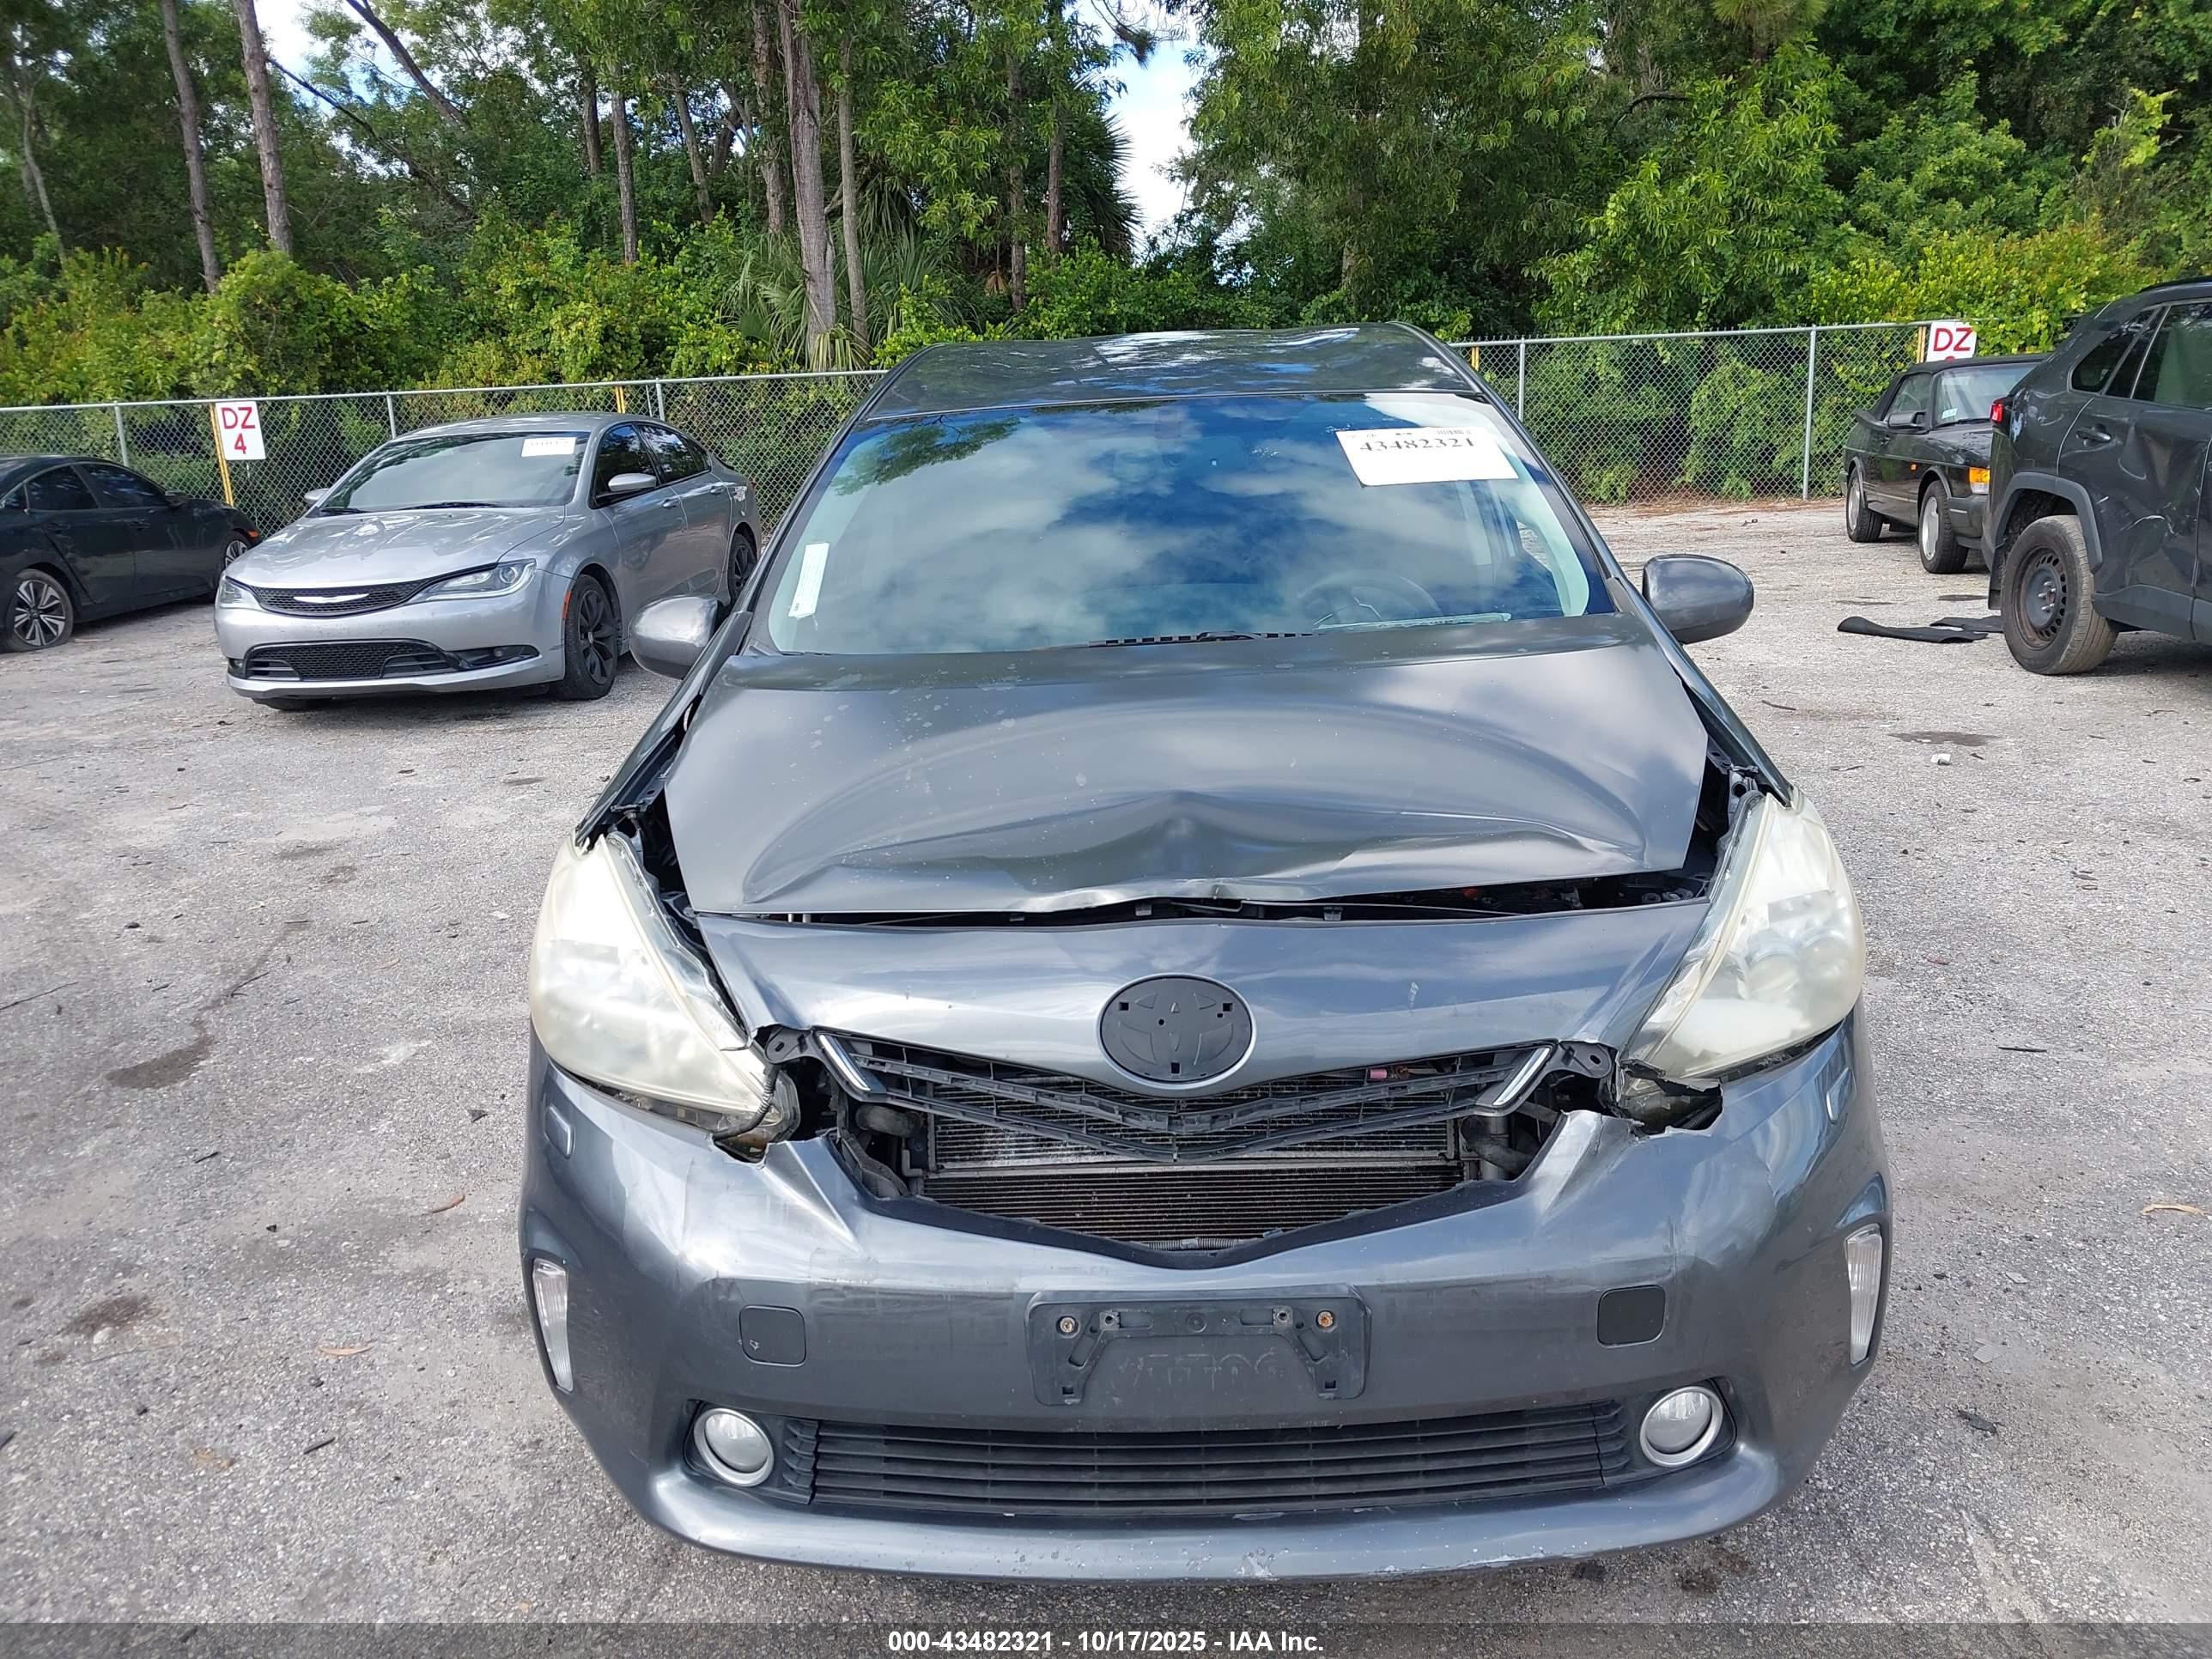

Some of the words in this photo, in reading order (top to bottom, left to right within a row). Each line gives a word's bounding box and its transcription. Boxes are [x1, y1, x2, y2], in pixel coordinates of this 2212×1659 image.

[1933, 326, 1973, 352] DZ
[221, 406, 256, 429] DZ
[234, 432, 247, 455] 4
[1359, 437, 1474, 452] 43482321
